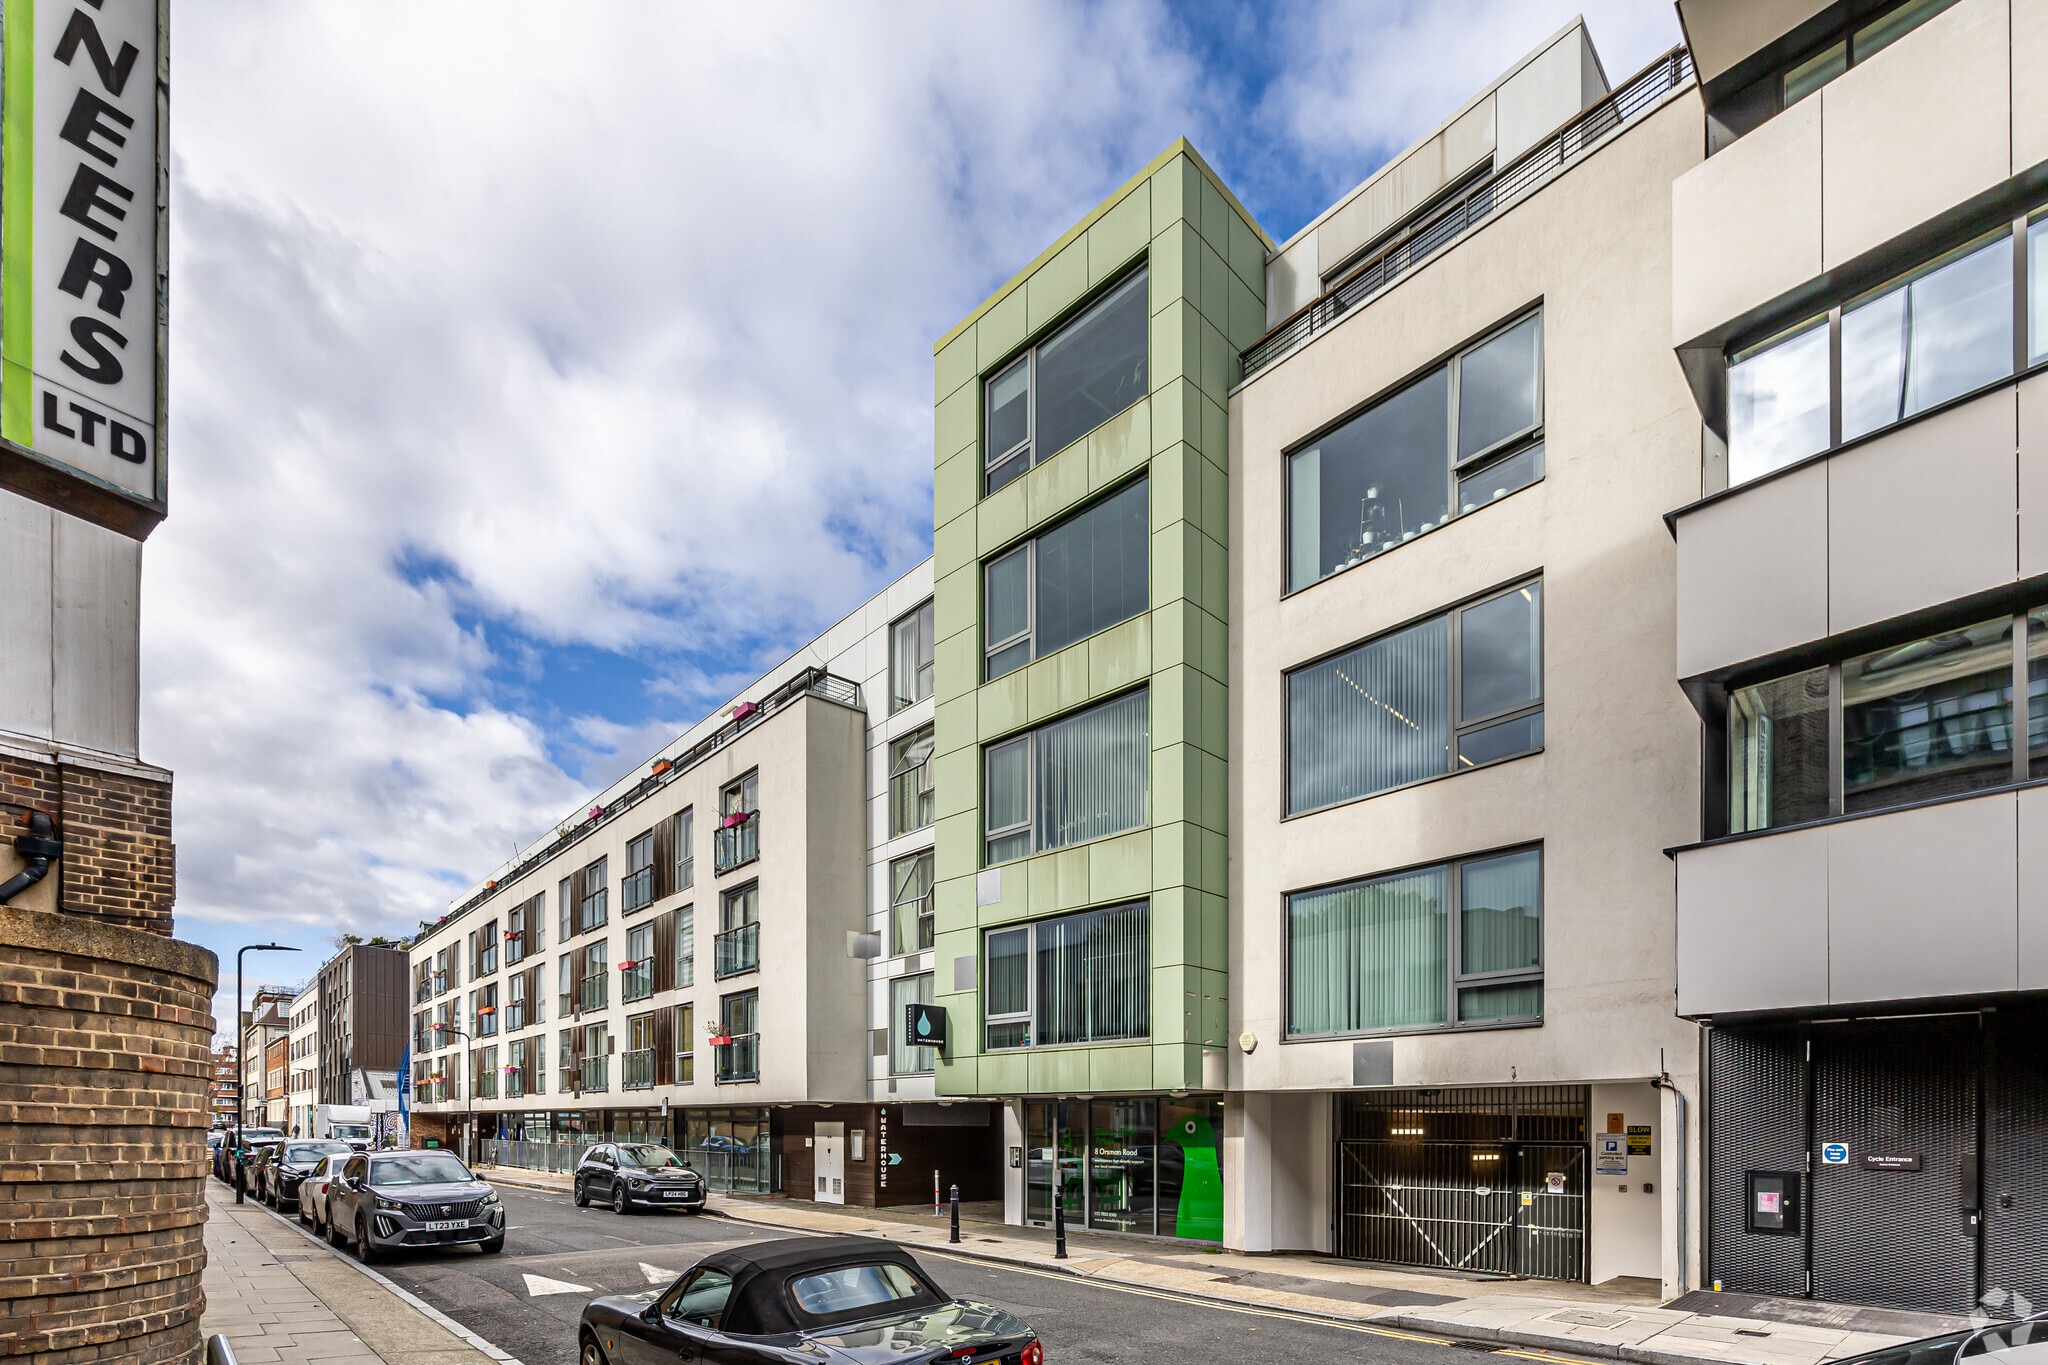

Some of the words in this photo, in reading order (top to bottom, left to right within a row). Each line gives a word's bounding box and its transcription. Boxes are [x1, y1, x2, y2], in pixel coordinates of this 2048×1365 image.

[53, 0, 140, 386] NEERS
[43, 390, 147, 465] LTD
[1608, 1142, 1615, 1150] P
[1094, 1147, 1099, 1155] 8
[1099, 1147, 1122, 1156] Orsman
[1122, 1148, 1138, 1156] Road
[1867, 1155, 1884, 1163] Cycle
[429, 1222, 449, 1230] LT23
[451, 1221, 466, 1229] YXE
